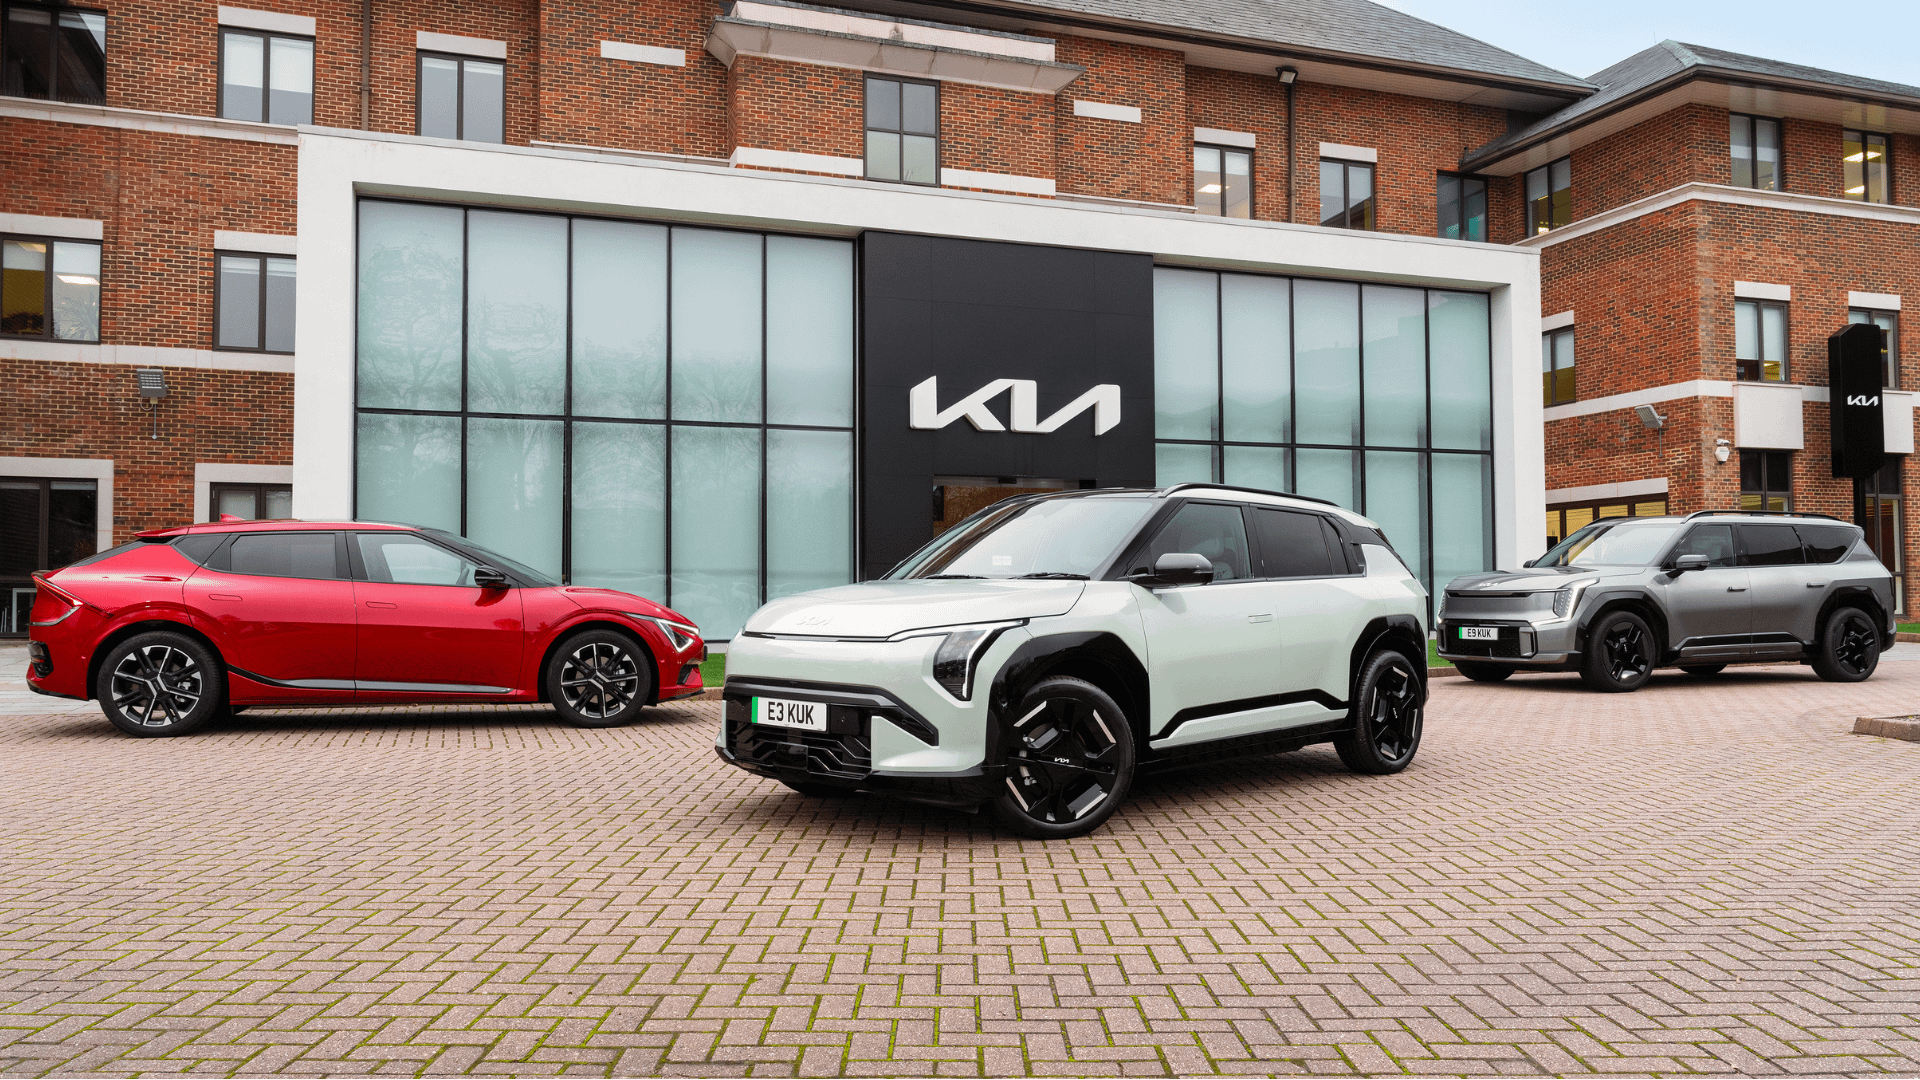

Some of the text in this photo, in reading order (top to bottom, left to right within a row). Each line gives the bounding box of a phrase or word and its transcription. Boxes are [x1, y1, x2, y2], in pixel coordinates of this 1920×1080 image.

[910, 375, 1121, 437] KIA
[1847, 395, 1879, 407] KIA
[1467, 628, 1492, 638] E9 KUK
[768, 701, 814, 725] E3 KUK
